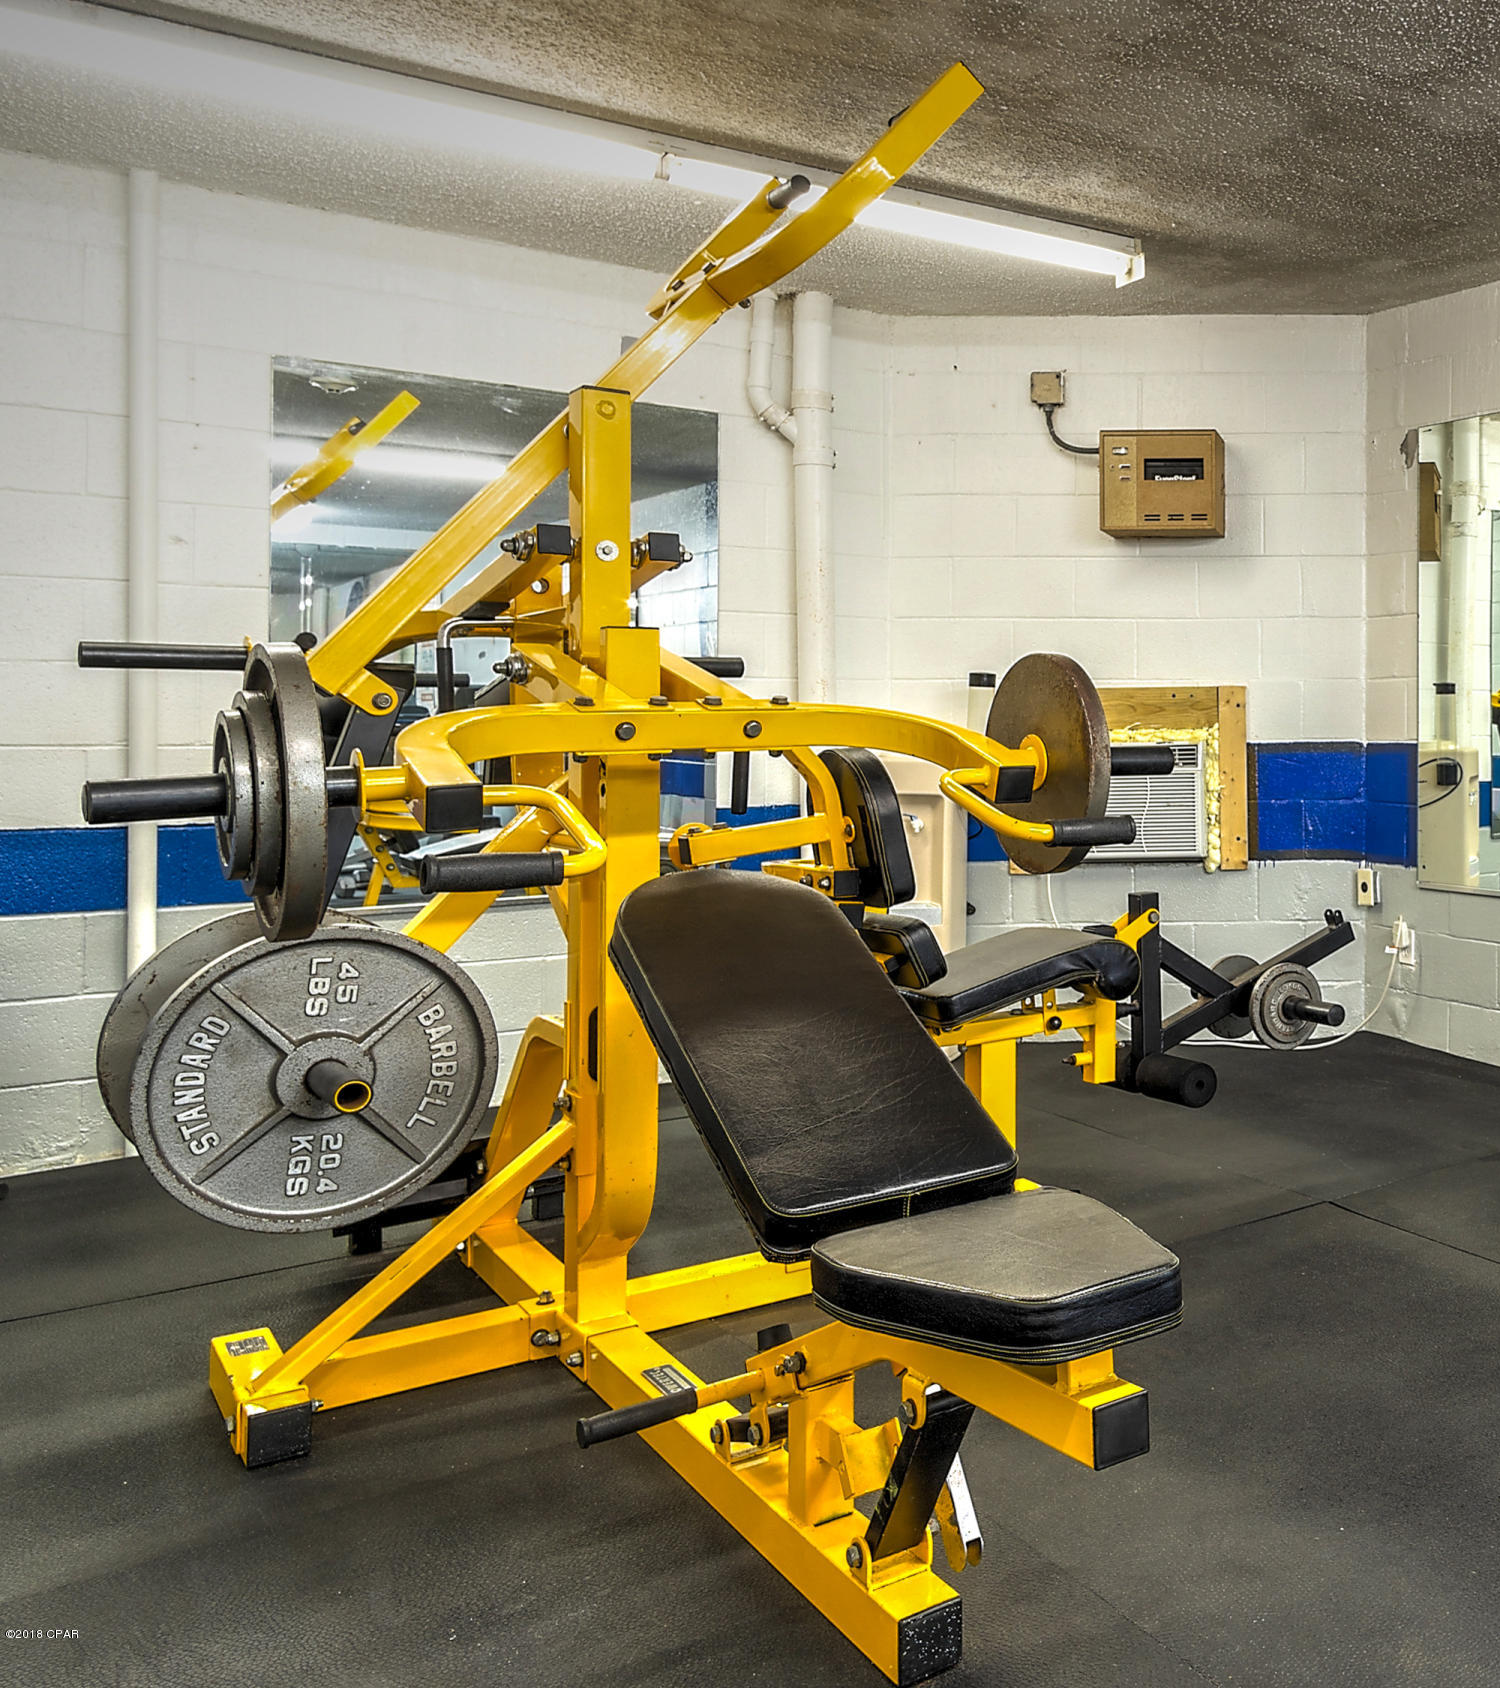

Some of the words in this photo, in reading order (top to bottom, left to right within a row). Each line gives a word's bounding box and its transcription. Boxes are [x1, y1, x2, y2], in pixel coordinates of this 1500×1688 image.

[305, 956, 333, 1018] LBS
[336, 960, 360, 1005] 45
[171, 1014, 232, 1156] STANDARD
[405, 1002, 459, 1130] BARBELL
[285, 1134, 315, 1197] KGS
[315, 1132, 344, 1195] 20.4
